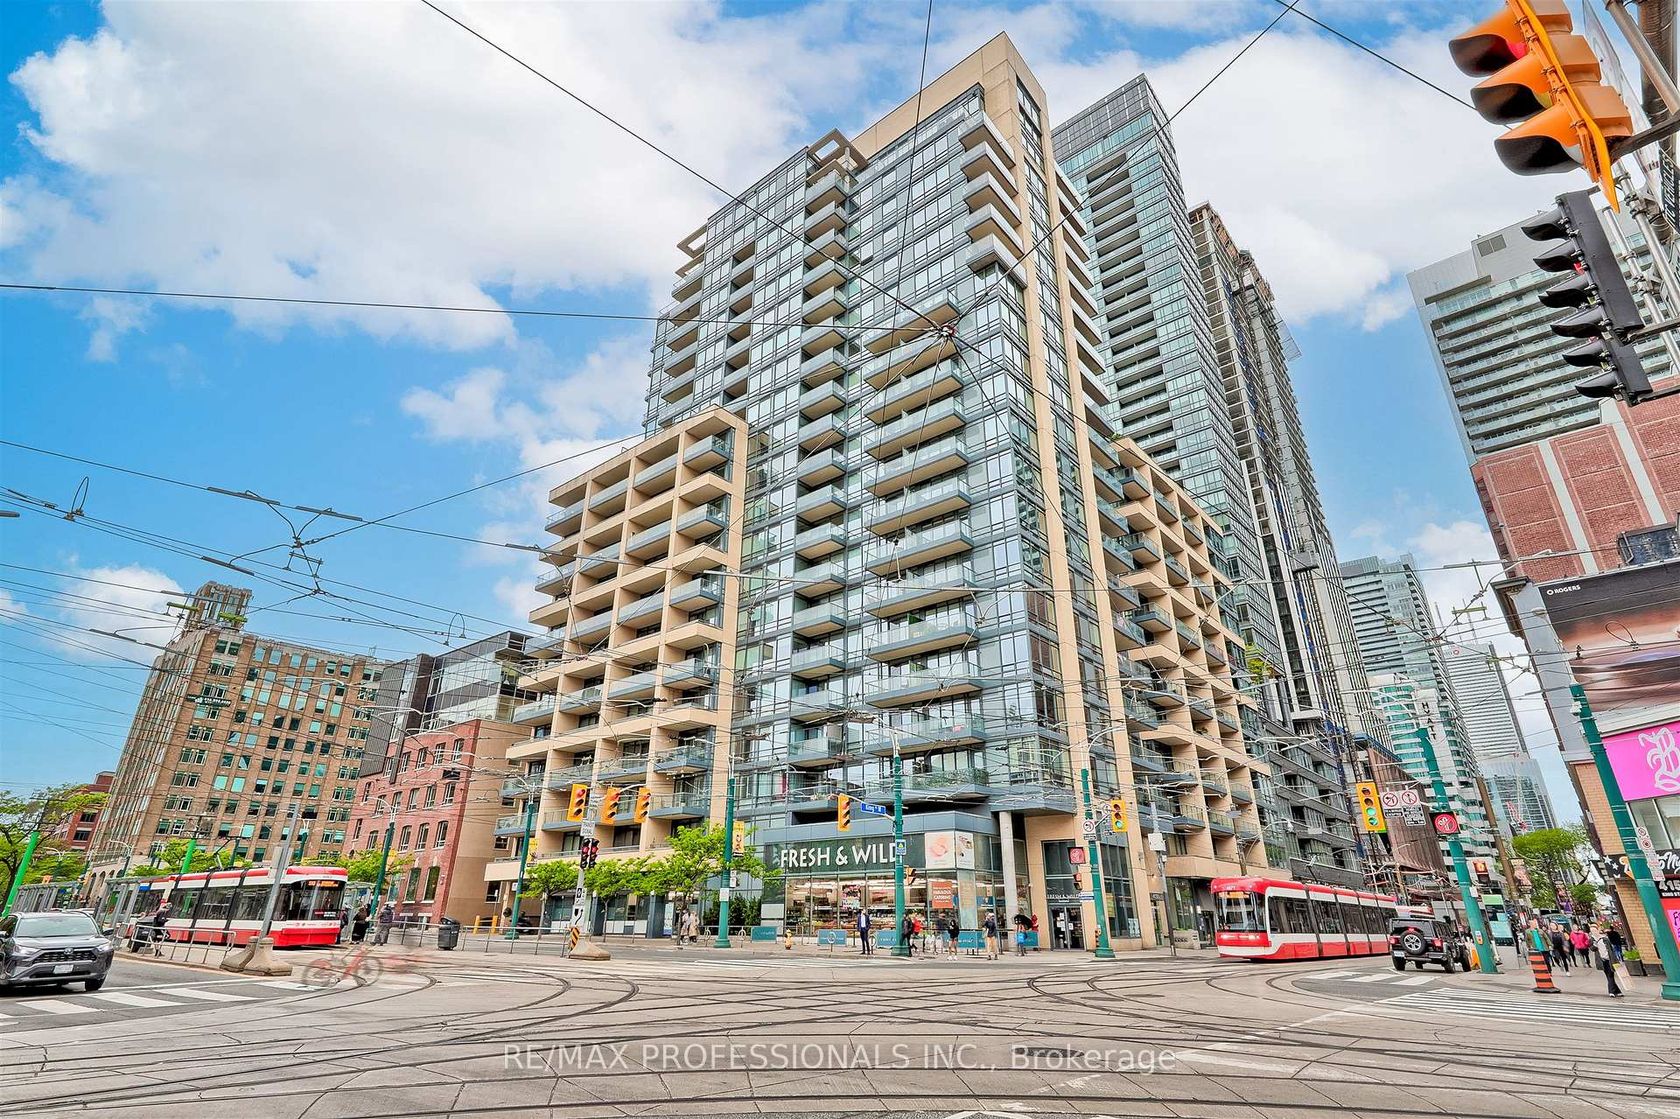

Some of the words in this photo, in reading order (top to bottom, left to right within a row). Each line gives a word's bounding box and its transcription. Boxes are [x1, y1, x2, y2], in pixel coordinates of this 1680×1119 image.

[1662, 153, 1675, 207] VEHICLES
[1554, 584, 1581, 594] ROGERS
[1421, 701, 1437, 740] HYATT
[780, 846, 830, 868] FRESH
[835, 845, 848, 865] &
